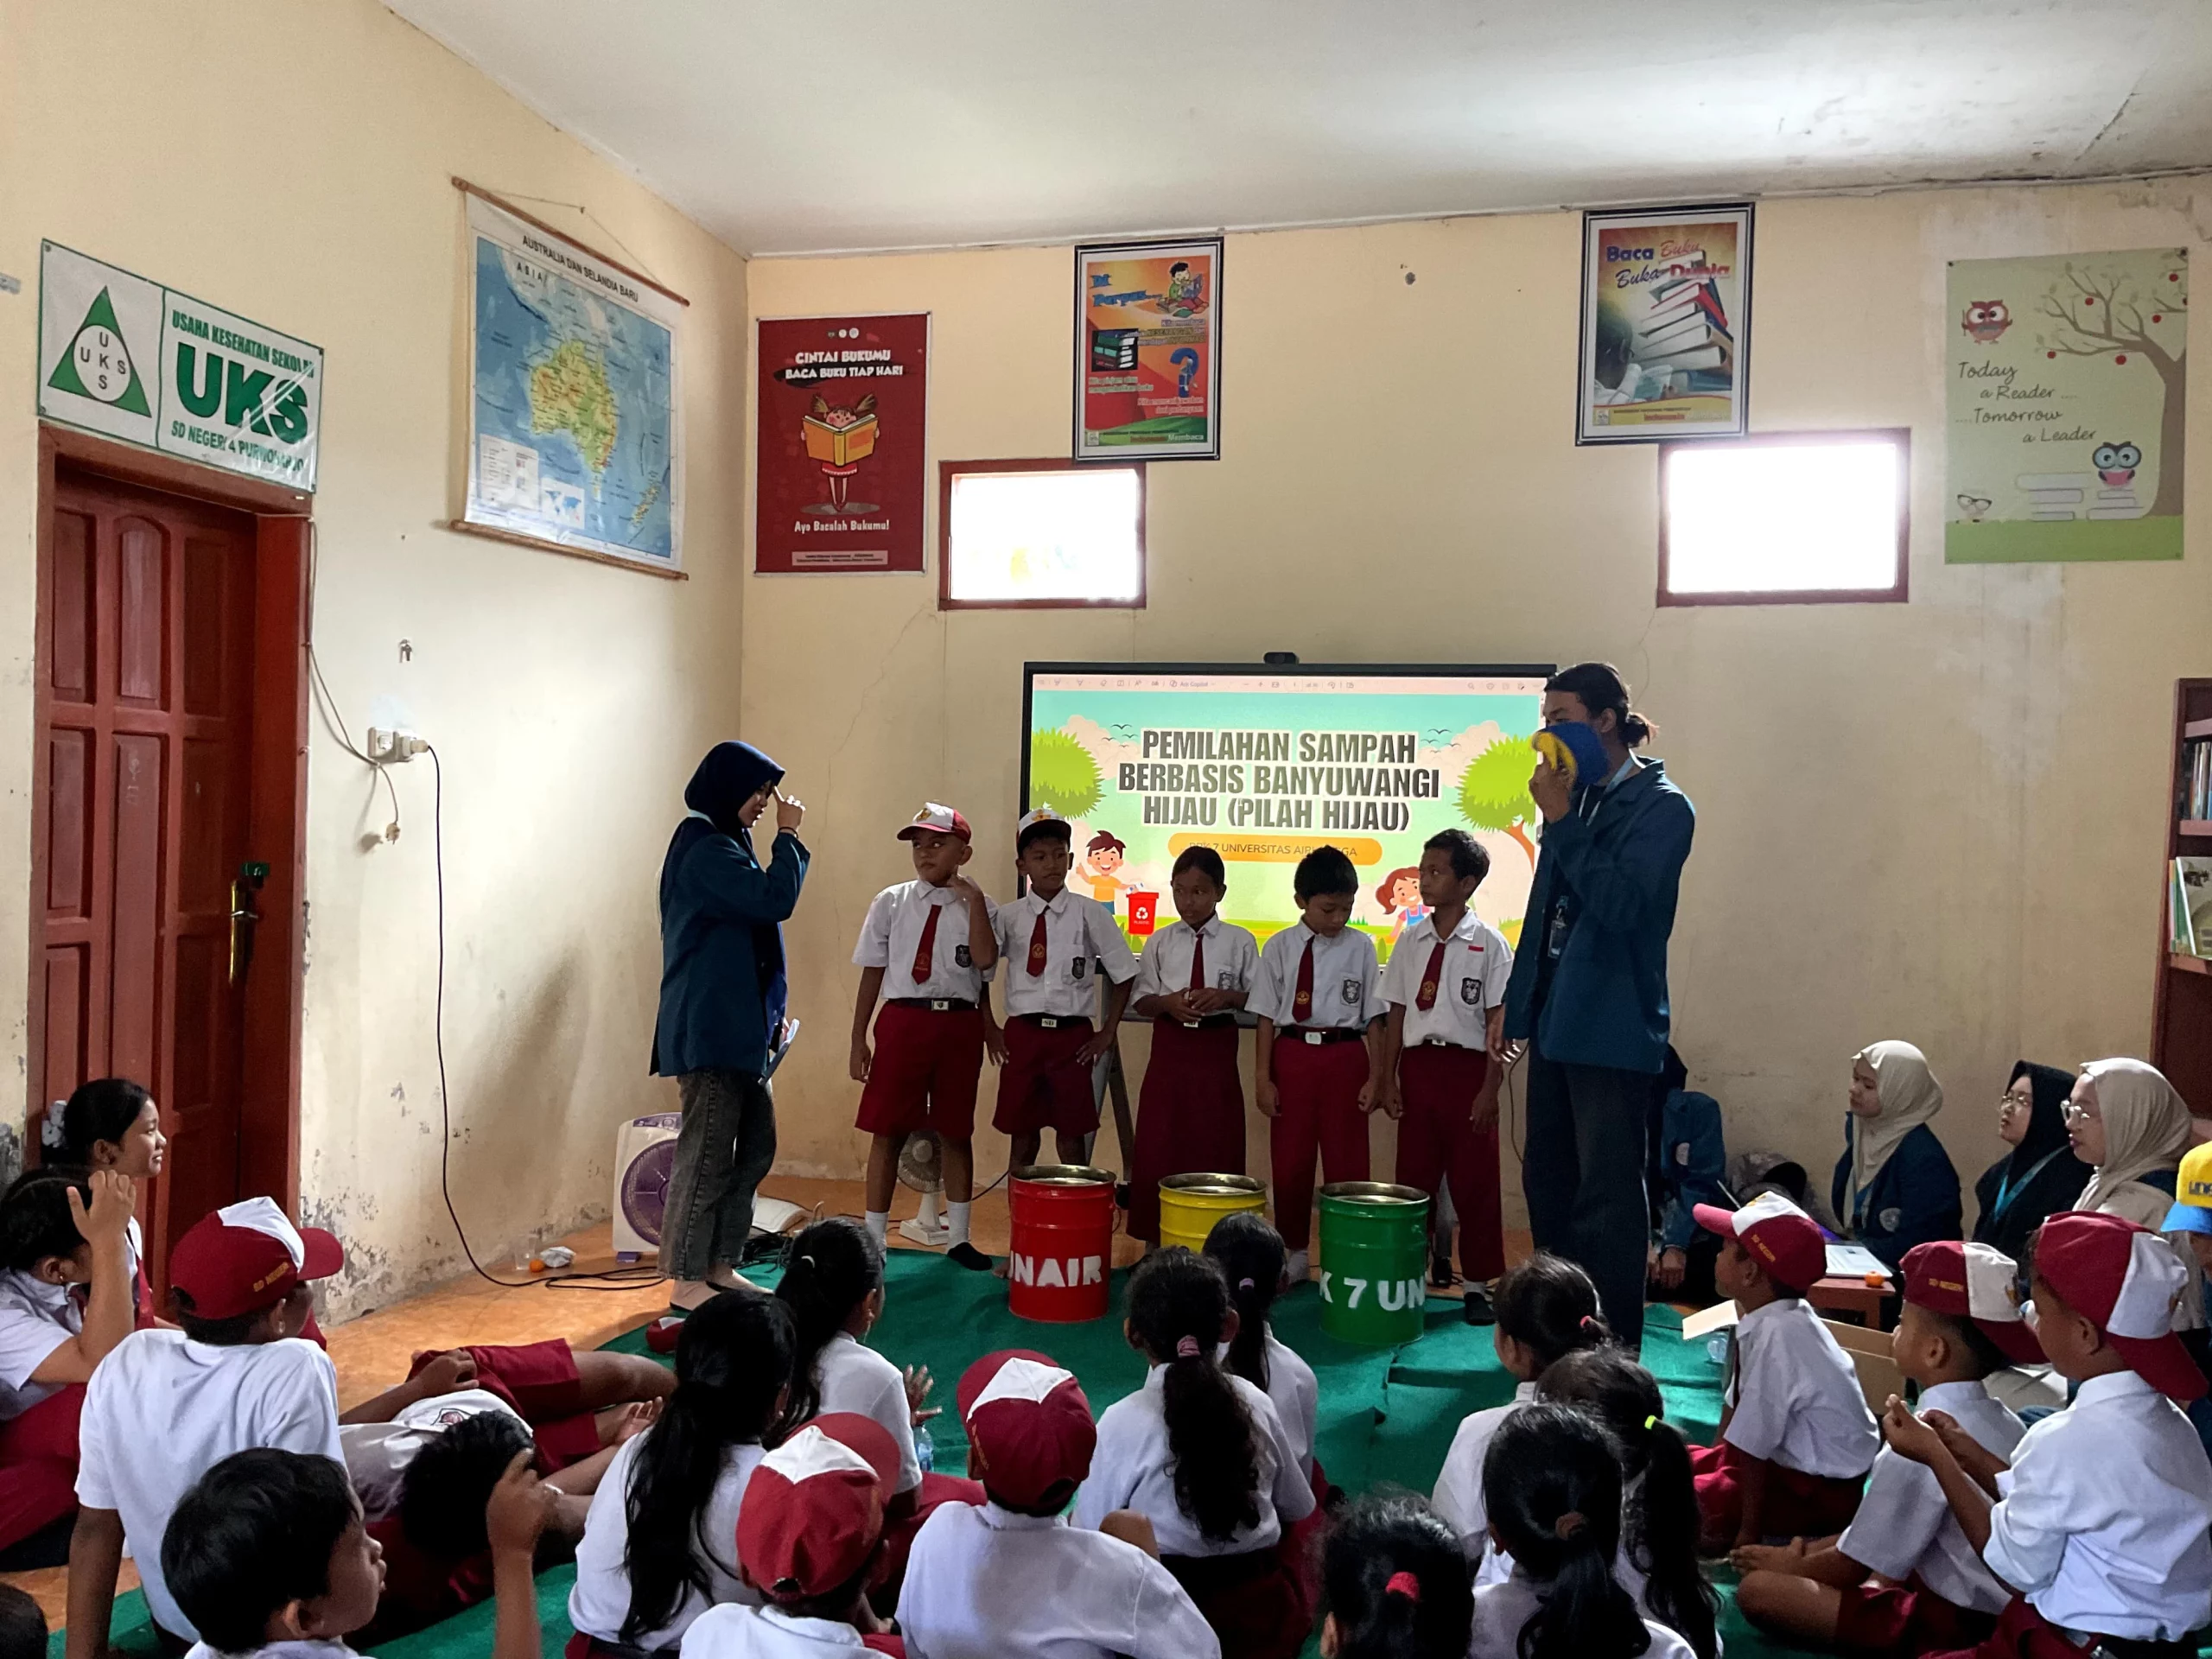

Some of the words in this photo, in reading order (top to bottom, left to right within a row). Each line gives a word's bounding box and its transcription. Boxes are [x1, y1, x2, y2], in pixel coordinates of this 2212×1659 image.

[1606, 245, 1655, 263] Baca
[1660, 238, 1700, 257] Buku
[523, 235, 565, 265] AUSTRALIA
[567, 257, 582, 274] DAN
[584, 266, 618, 292] SELANDIA
[620, 284, 639, 302] BARU
[1615, 264, 1661, 289] Buka
[172, 309, 209, 340] USAHA
[212, 325, 270, 363] KESEHATAN
[795, 351, 838, 365] CINTAI
[841, 349, 891, 363] BUKUMU
[785, 368, 817, 379] BACA
[820, 366, 847, 378] BUKU
[849, 366, 874, 378] TIAP
[876, 365, 904, 376] HARI
[1958, 359, 2018, 385] Today
[176, 341, 308, 445] UKS
[1996, 384, 2056, 401] Reader
[171, 420, 186, 438] SD
[188, 425, 226, 451] NEGERI
[228, 440, 236, 453] 4
[2022, 433, 2037, 443] a
[2041, 426, 2097, 442] Leader
[794, 520, 811, 535] Ayo
[813, 520, 848, 532] Bacalah
[850, 519, 890, 531] Bukumu!
[1143, 730, 1290, 761] PEMILAHAN
[1300, 733, 1415, 764] SAMPAH
[1119, 763, 1244, 794] BERBASIS
[1254, 766, 1439, 798] BANYUWANGI
[1143, 796, 1217, 826] HIJAU
[1228, 798, 1313, 830] (PILAH
[1322, 800, 1410, 832] HIJAU)
[1212, 843, 1220, 852] 7
[1222, 843, 1291, 855] UNIVERSITAS
[1344, 1277, 1367, 1309] 7
